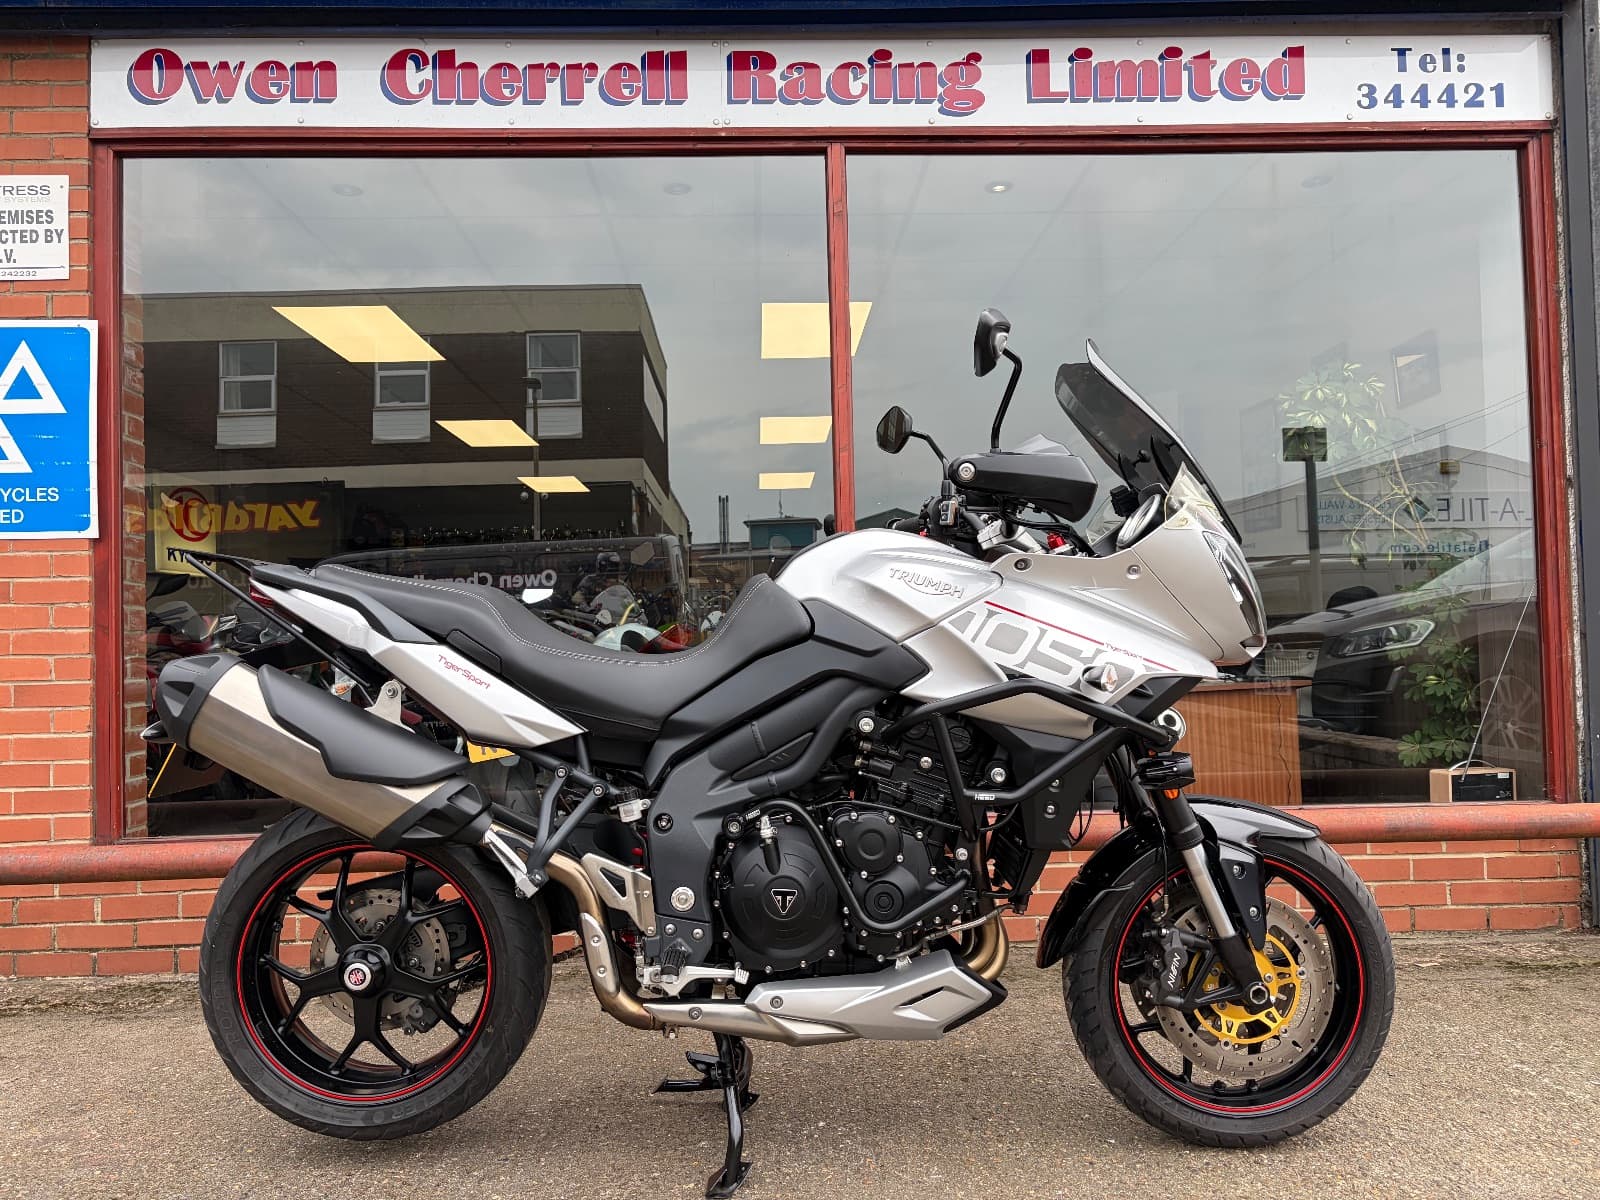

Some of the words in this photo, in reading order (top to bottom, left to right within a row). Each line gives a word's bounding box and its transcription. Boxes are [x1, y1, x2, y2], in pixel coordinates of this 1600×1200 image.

[1390, 47, 1467, 73] Tel:
[127, 48, 338, 105] Owen
[380, 48, 689, 106] Cherrell
[727, 47, 986, 117] Racing
[1026, 45, 1306, 104] Limited
[1356, 81, 1507, 110] 344421
[44, 228, 64, 244] BY
[0, 487, 60, 502] YCLES
[888, 566, 965, 599] TRIUMPH
[438, 653, 491, 690] TigerSport
